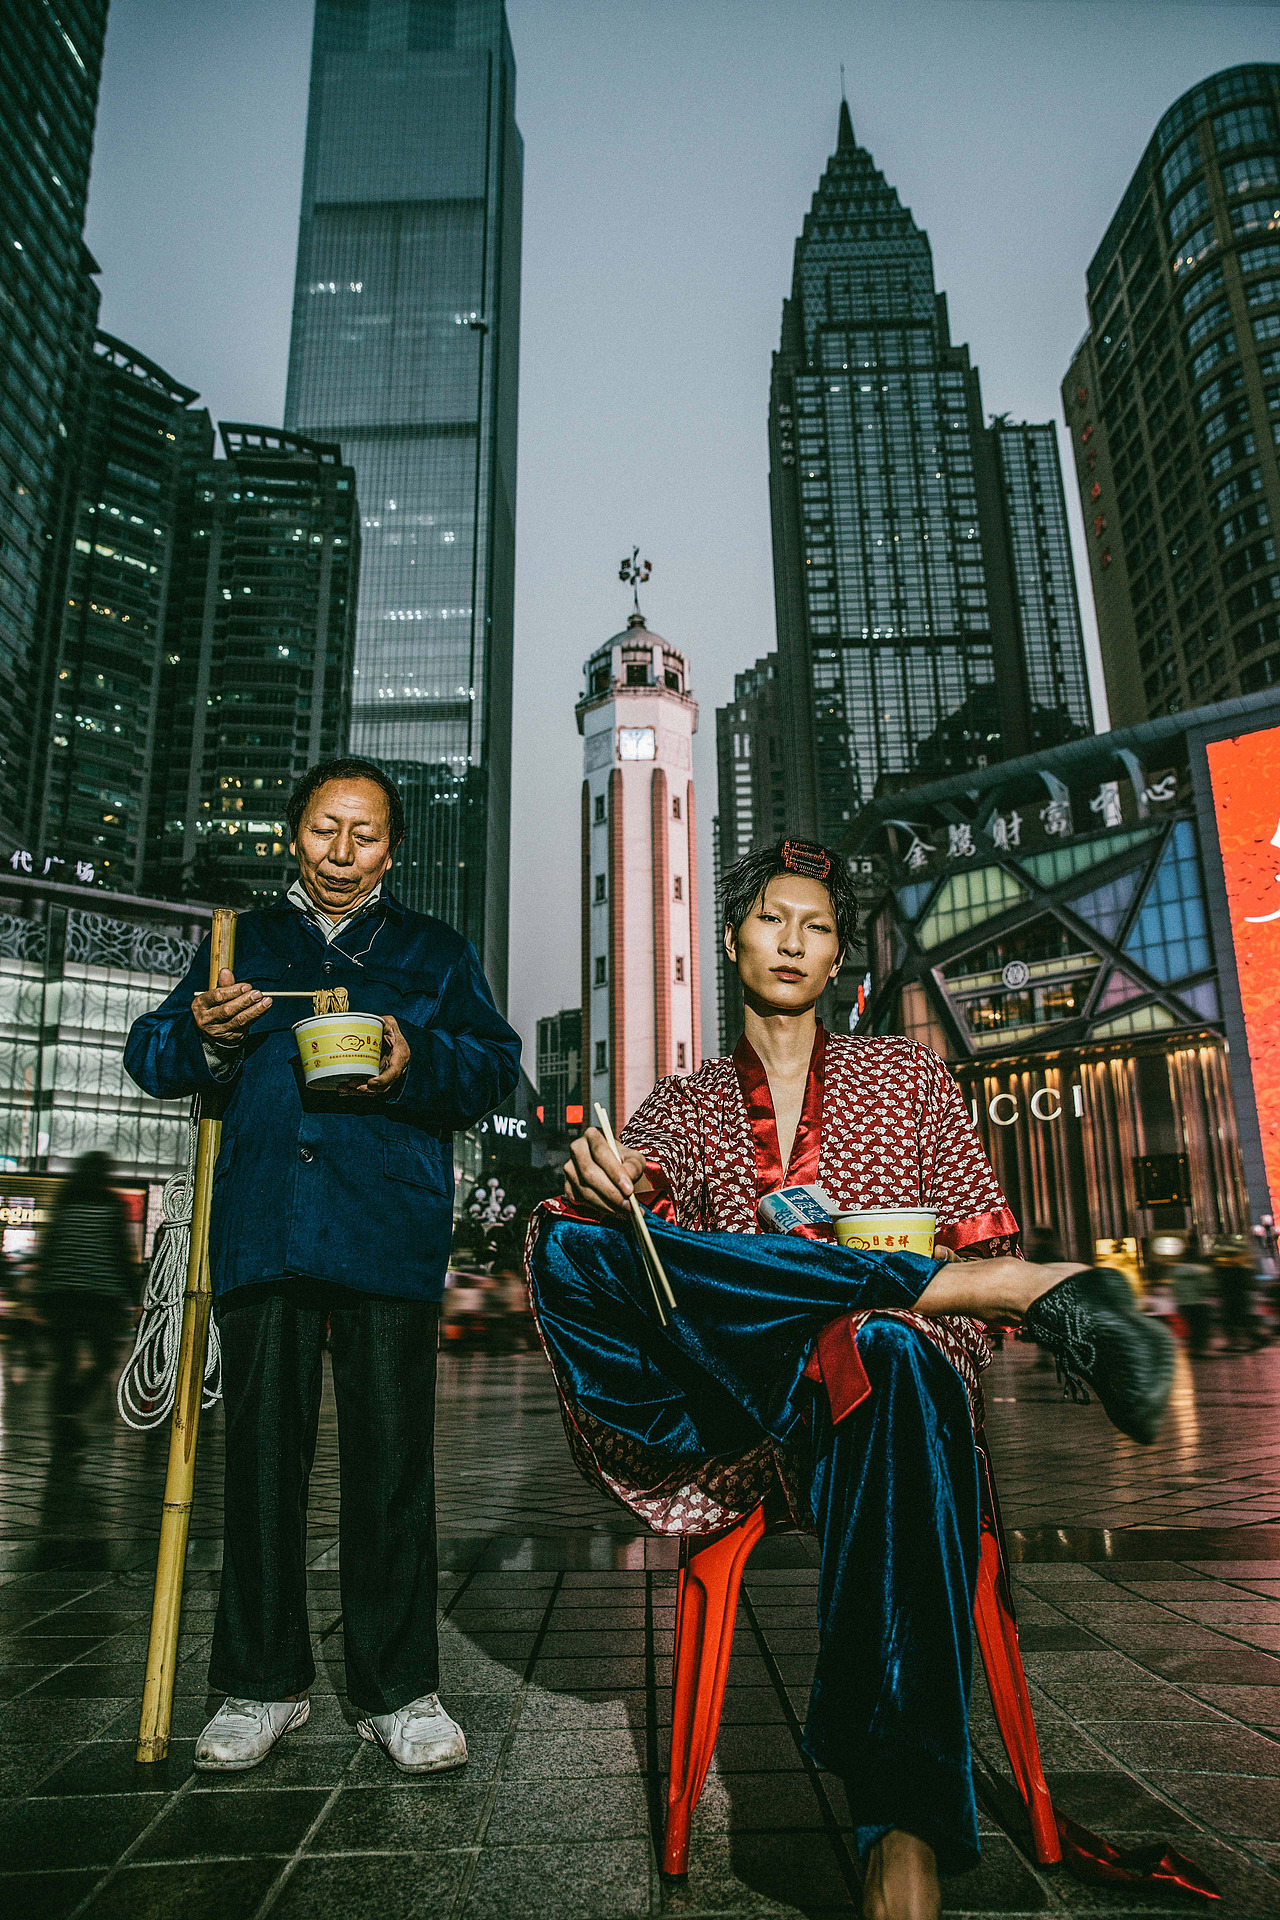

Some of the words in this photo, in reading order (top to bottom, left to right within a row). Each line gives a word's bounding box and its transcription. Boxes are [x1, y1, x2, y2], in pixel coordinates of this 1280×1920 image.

[9, 850, 95, 883] 代广场
[493, 1114, 528, 1139] WFC
